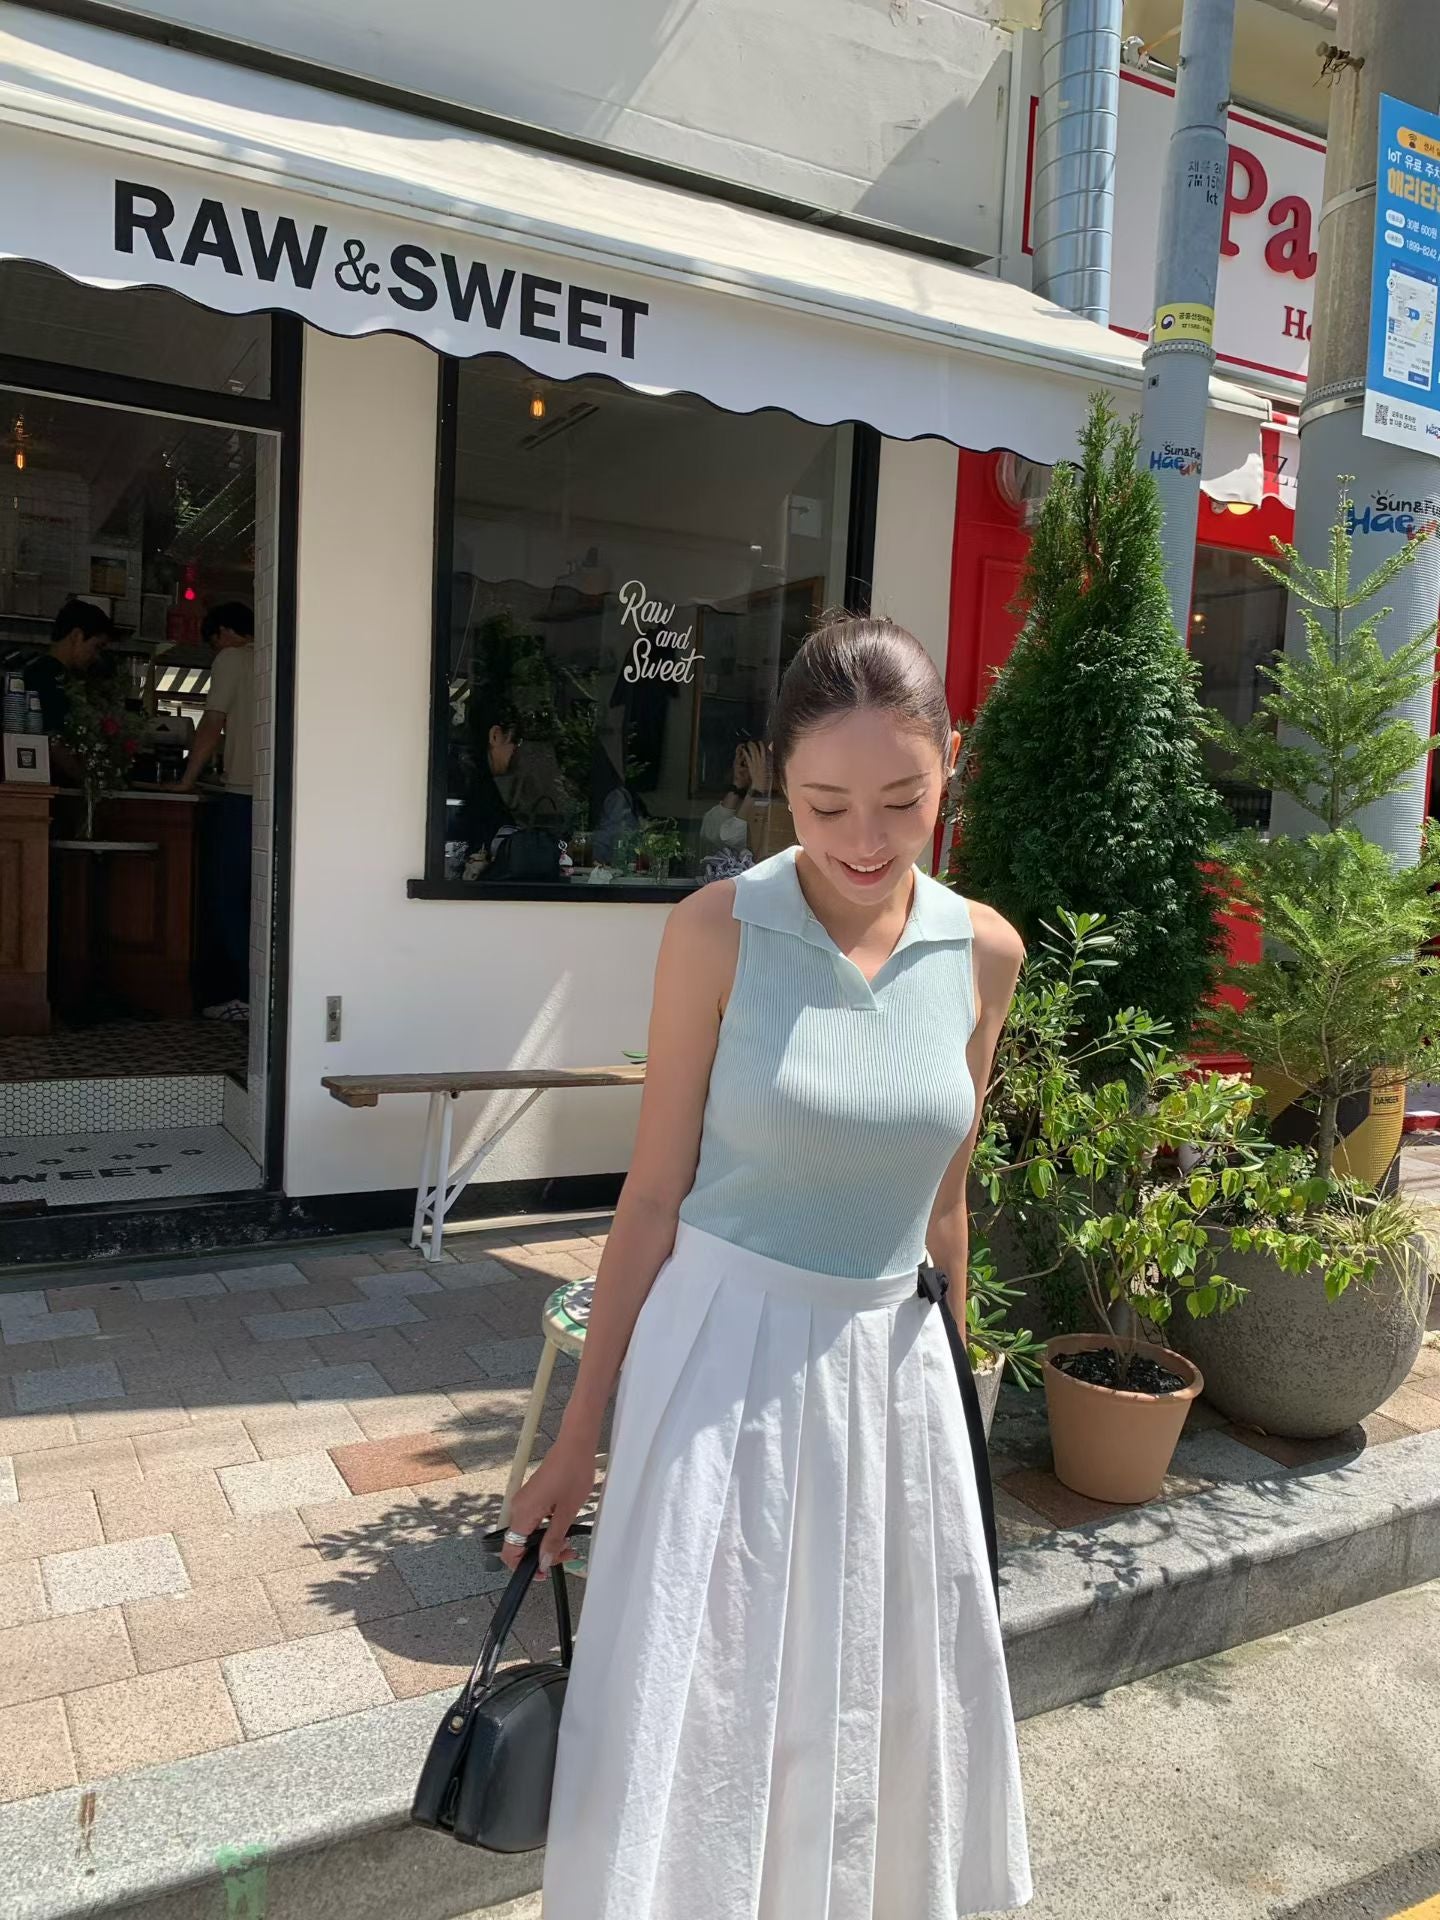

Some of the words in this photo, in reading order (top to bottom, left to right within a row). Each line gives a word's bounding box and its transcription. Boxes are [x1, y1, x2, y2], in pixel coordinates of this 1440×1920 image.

[1388, 147, 1402, 164] IoT
[1404, 154, 1422, 173] 유료
[619, 580, 675, 636] Raw
[656, 625, 693, 650] and
[624, 637, 705, 683] Sweet
